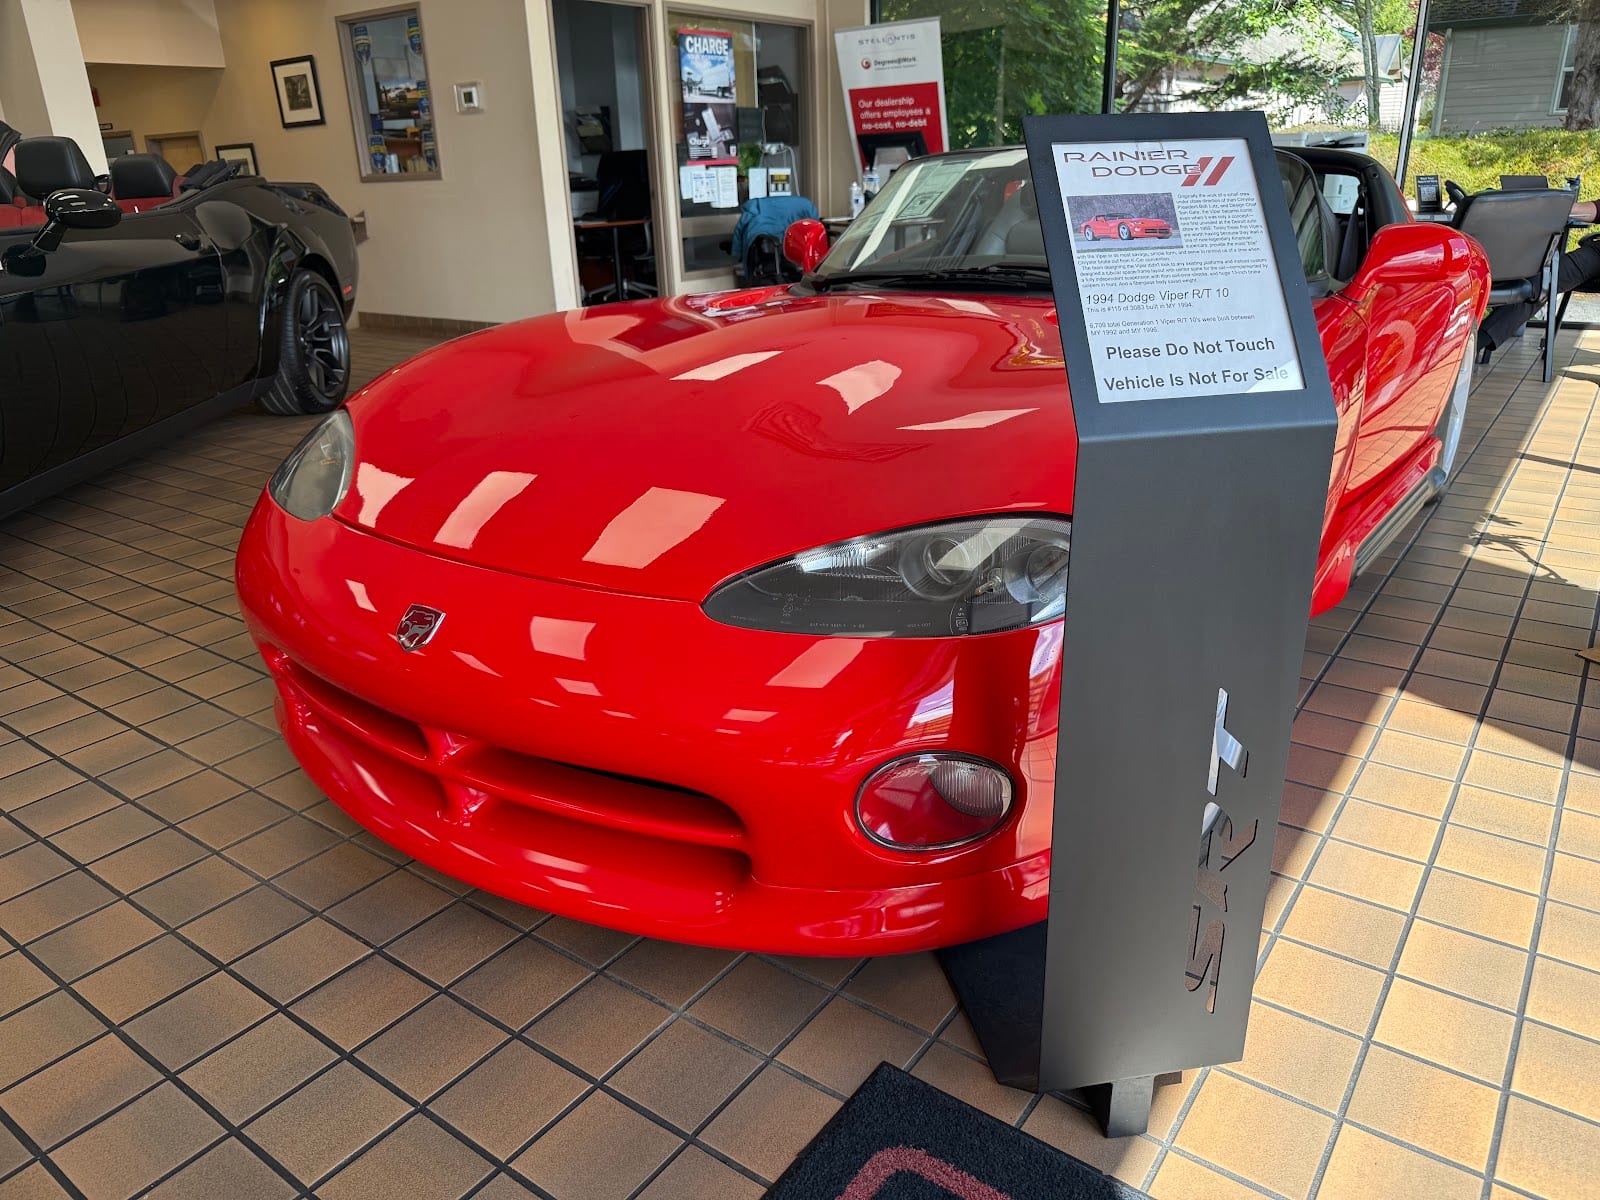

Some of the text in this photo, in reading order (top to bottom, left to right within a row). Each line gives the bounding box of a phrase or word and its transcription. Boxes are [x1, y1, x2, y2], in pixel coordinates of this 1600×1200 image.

[685, 35, 728, 55] CHARGE
[858, 33, 916, 45] STELLANTIS
[858, 96, 914, 108] Our dealership
[860, 110, 881, 119] offers
[883, 108, 923, 118] employees
[862, 119, 927, 130] no-cost, no-debt
[1063, 150, 1188, 162] RAINIER
[1091, 164, 1201, 176] DODGE
[1086, 287, 1229, 305] 1994 Dodge Viper R/T 10
[1106, 338, 1274, 358] Please Do Not Touch
[1104, 366, 1288, 390] Vehicle Is Not For Sale
[1184, 687, 1258, 1014] SRT
